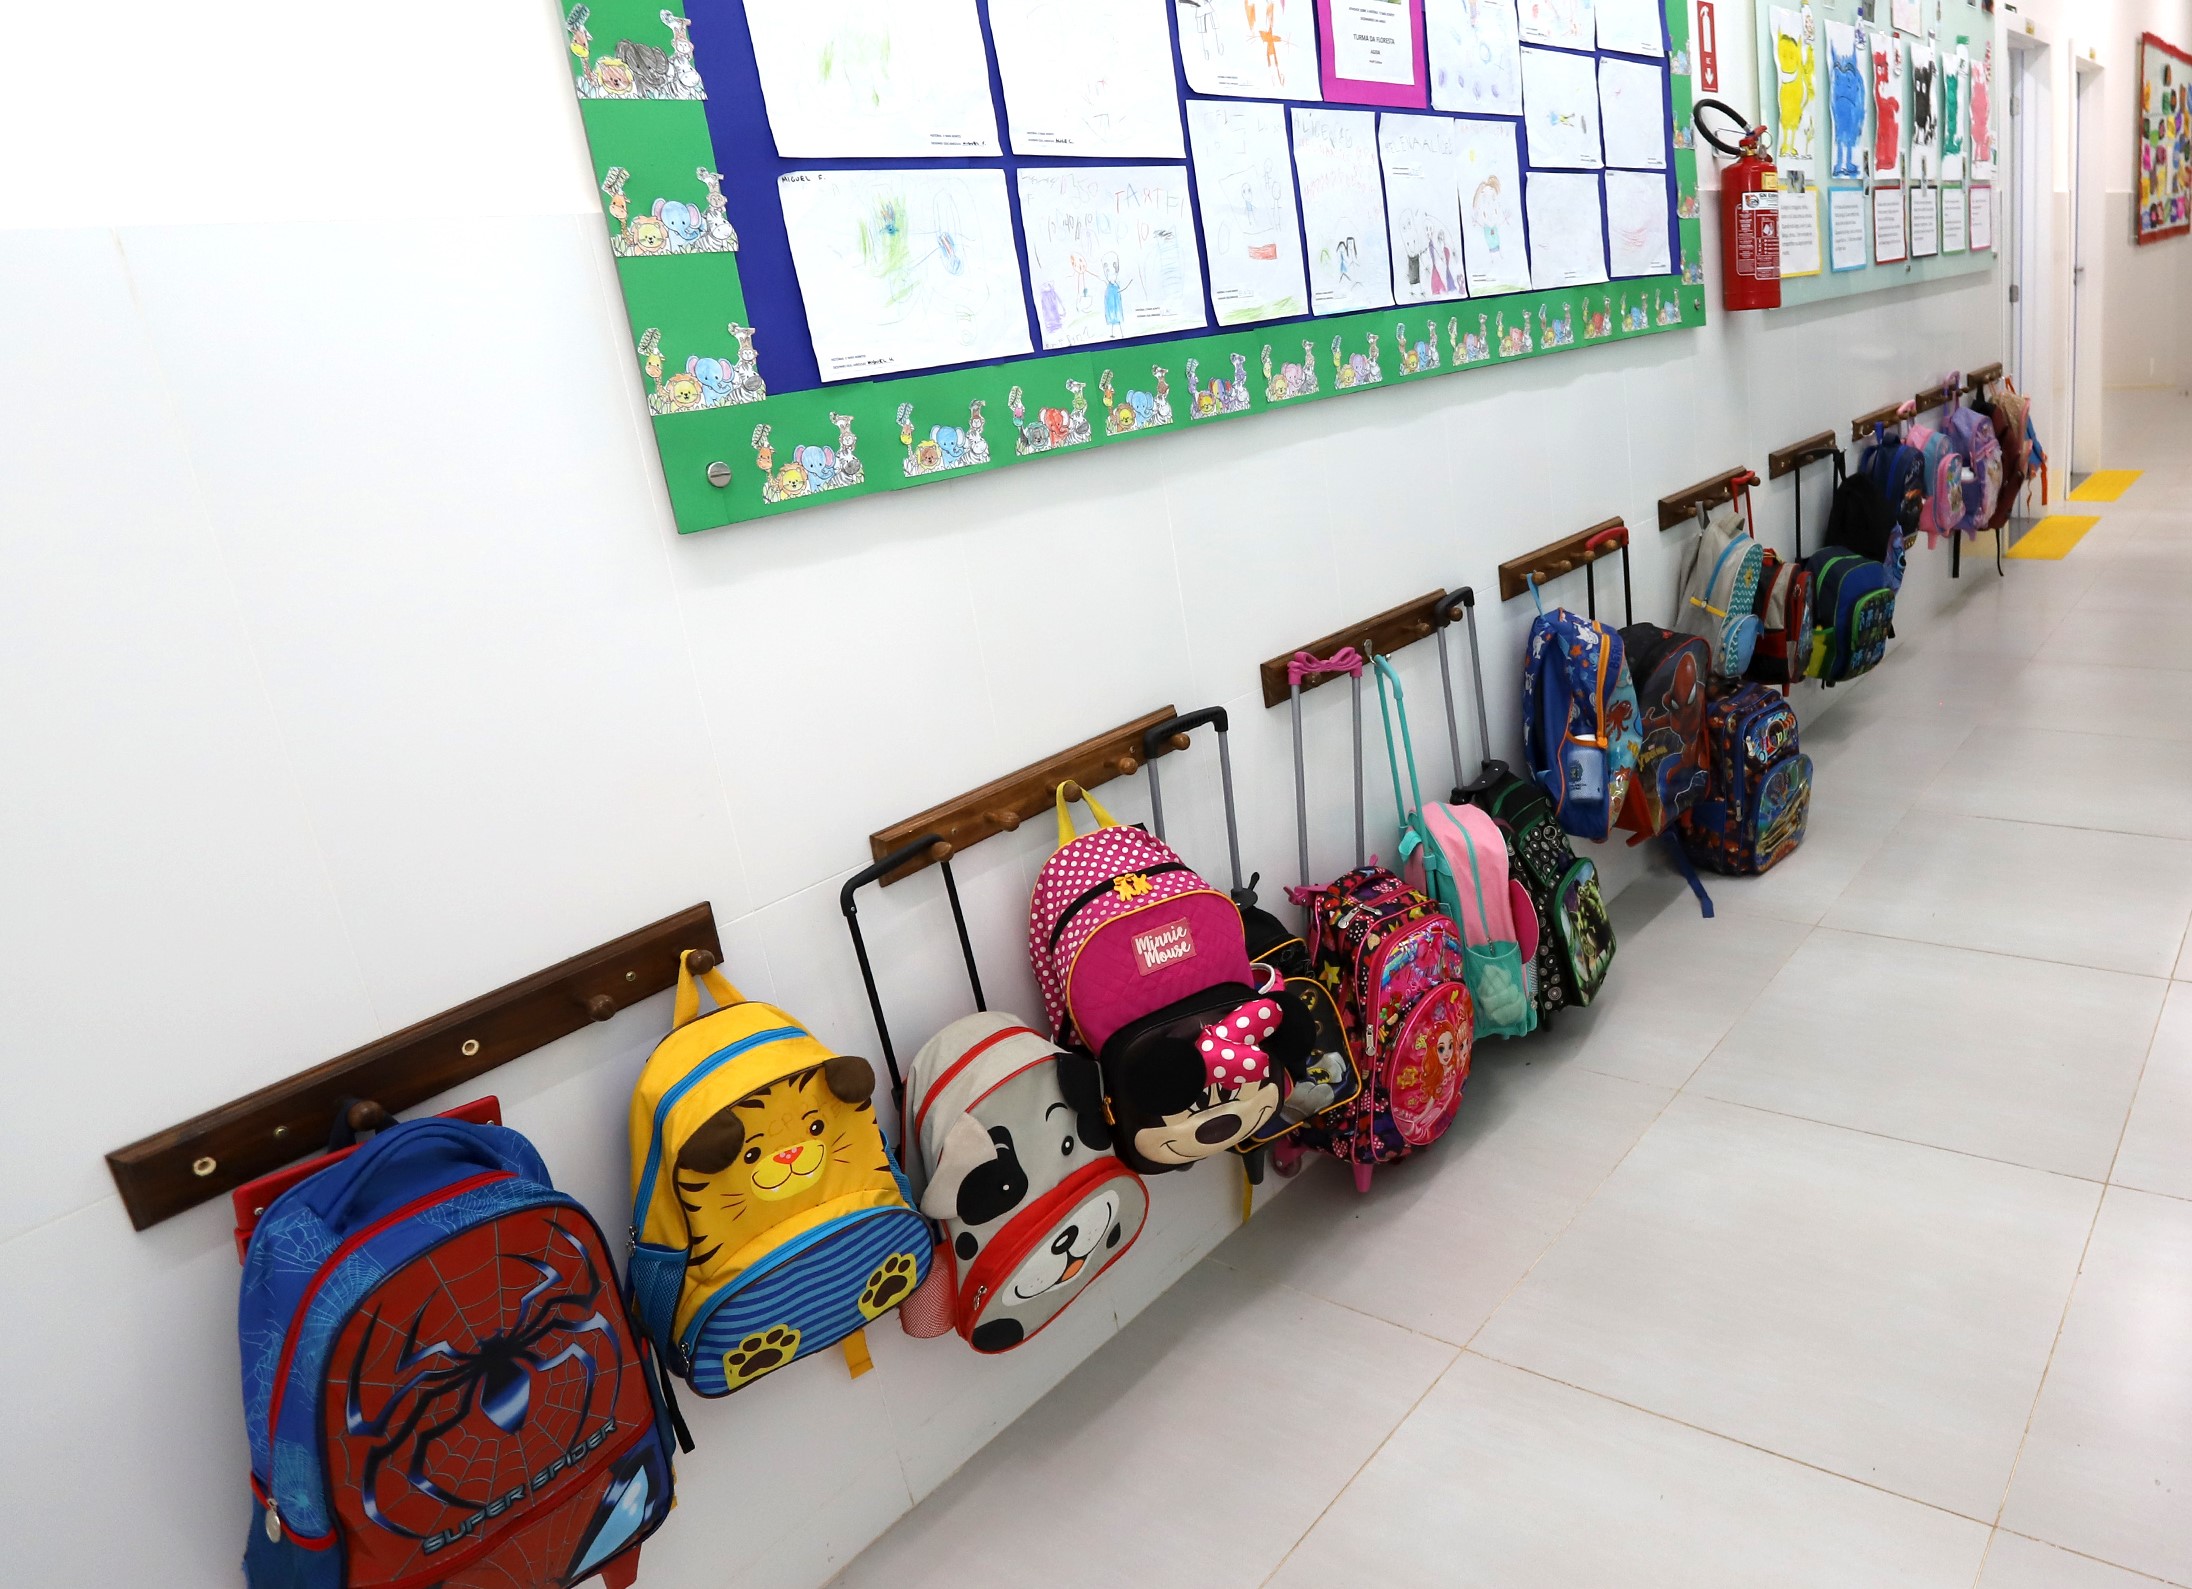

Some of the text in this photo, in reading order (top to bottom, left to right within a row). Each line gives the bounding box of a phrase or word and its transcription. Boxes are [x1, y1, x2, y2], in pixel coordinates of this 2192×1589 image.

[1353, 34, 1369, 42] TURMA
[781, 175, 811, 183] MIGUEL
[1135, 926, 1187, 955] Minnie
[1144, 941, 1191, 968] Mouse
[423, 1416, 617, 1556] SUPER SPIDER
